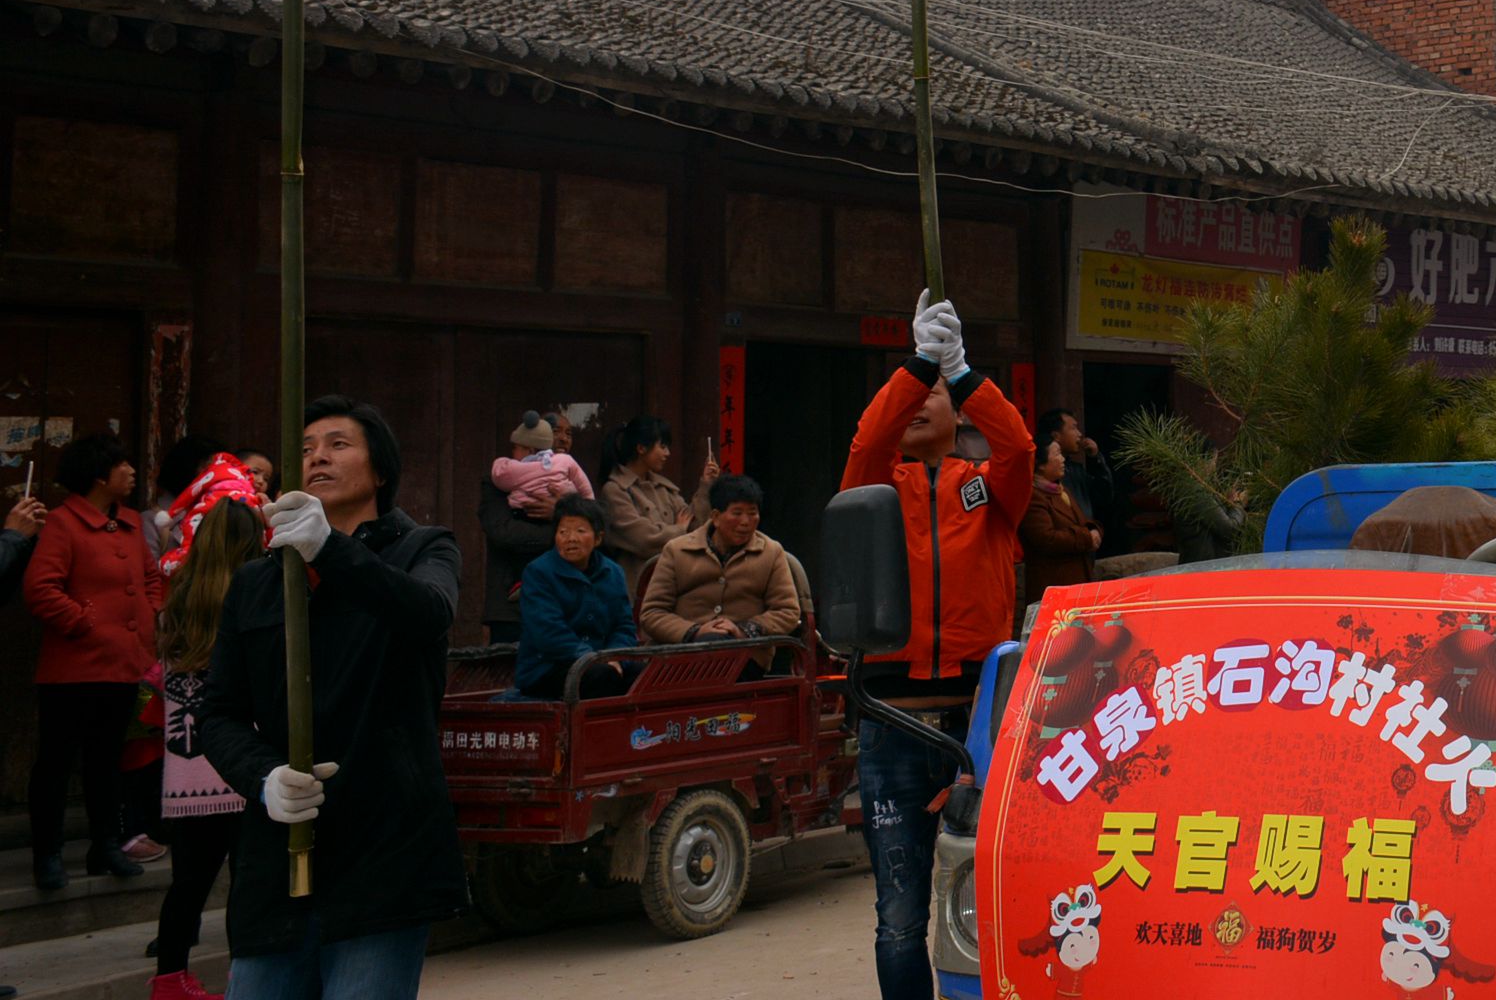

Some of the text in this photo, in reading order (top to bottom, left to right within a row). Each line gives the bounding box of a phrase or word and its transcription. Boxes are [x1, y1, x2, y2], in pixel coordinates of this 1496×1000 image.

[1101, 278, 1129, 289] ROTAM
[872, 814, 904, 829] Jeans
[1093, 809, 1418, 903] 天官赐福
[1135, 911, 1337, 954] 欢天喜地 福 福狗贺岁
